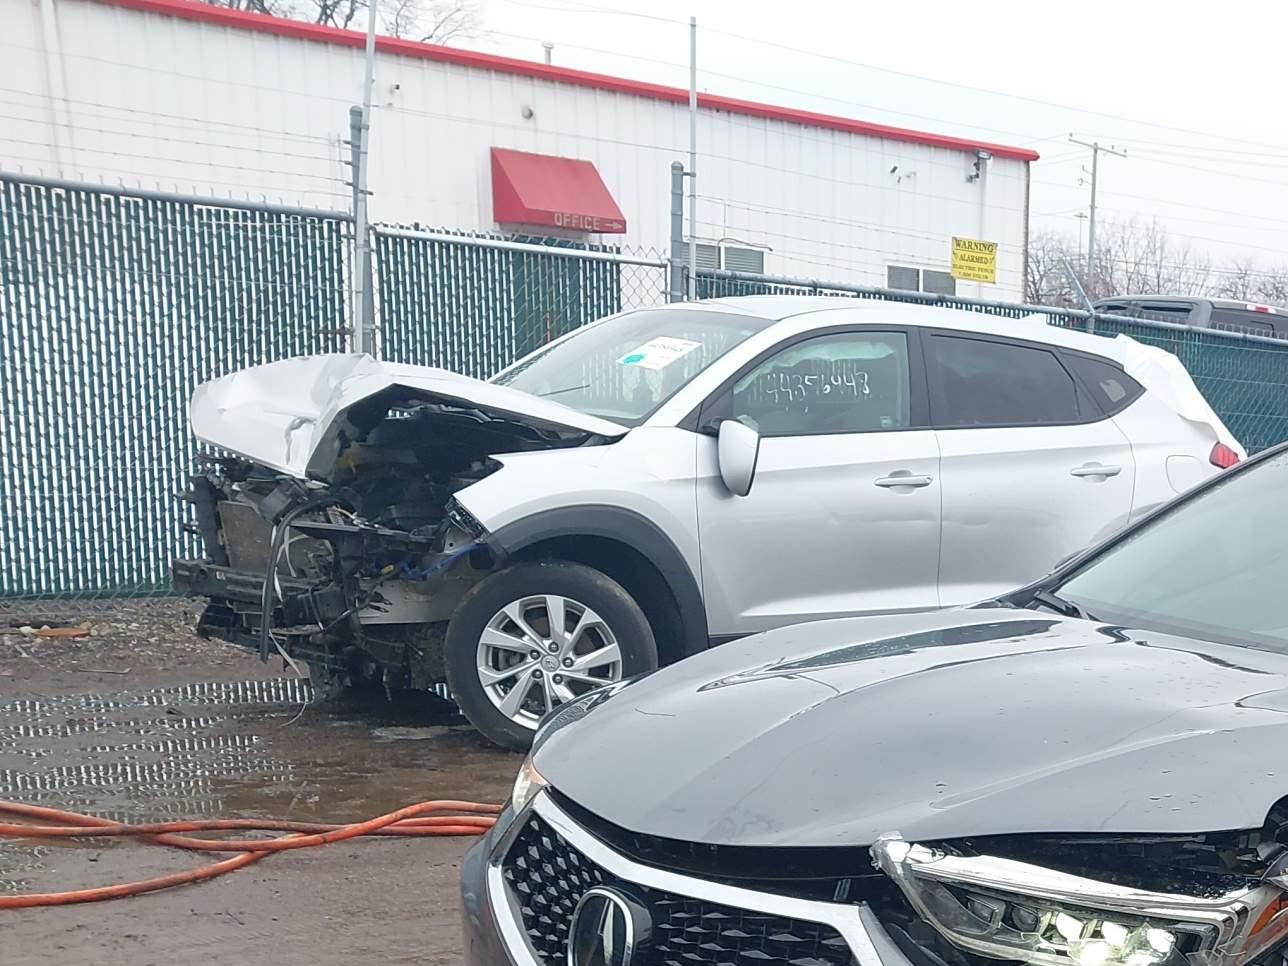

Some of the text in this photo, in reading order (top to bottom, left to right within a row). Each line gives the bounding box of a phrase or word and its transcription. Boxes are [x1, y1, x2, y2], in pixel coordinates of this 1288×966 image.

[554, 212, 600, 230] OFFICE
[955, 240, 993, 253] WARNING
[960, 254, 989, 264] ALARMED
